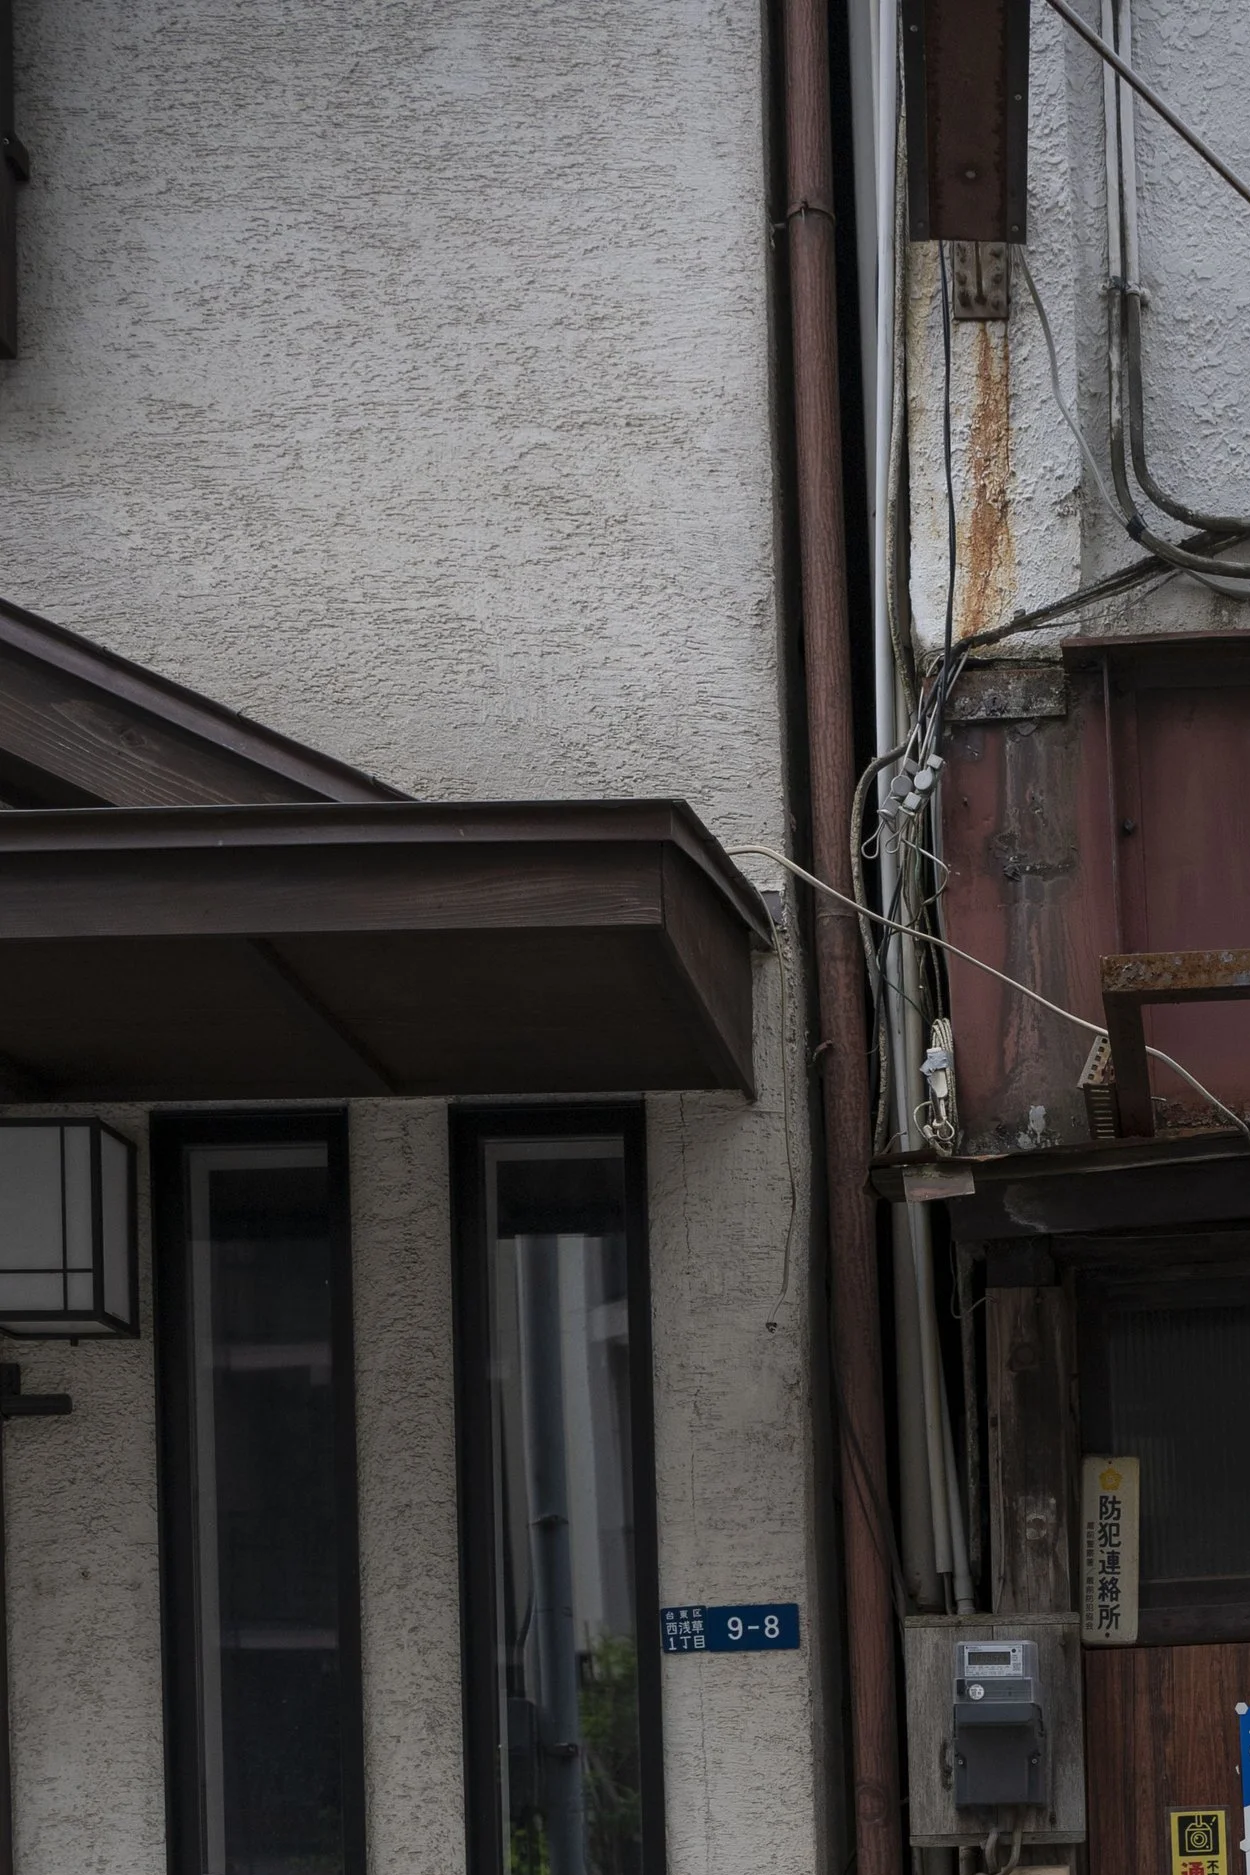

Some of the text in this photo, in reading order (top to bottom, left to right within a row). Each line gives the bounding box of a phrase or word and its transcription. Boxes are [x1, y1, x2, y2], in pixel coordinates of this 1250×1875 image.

[1098, 1495, 1121, 1630] 防犯連絡所
[665, 1609, 702, 1620] 台東区
[666, 1620, 705, 1635] 西浅草
[727, 1615, 780, 1640] 9-8
[668, 1635, 705, 1650] 1丁目
